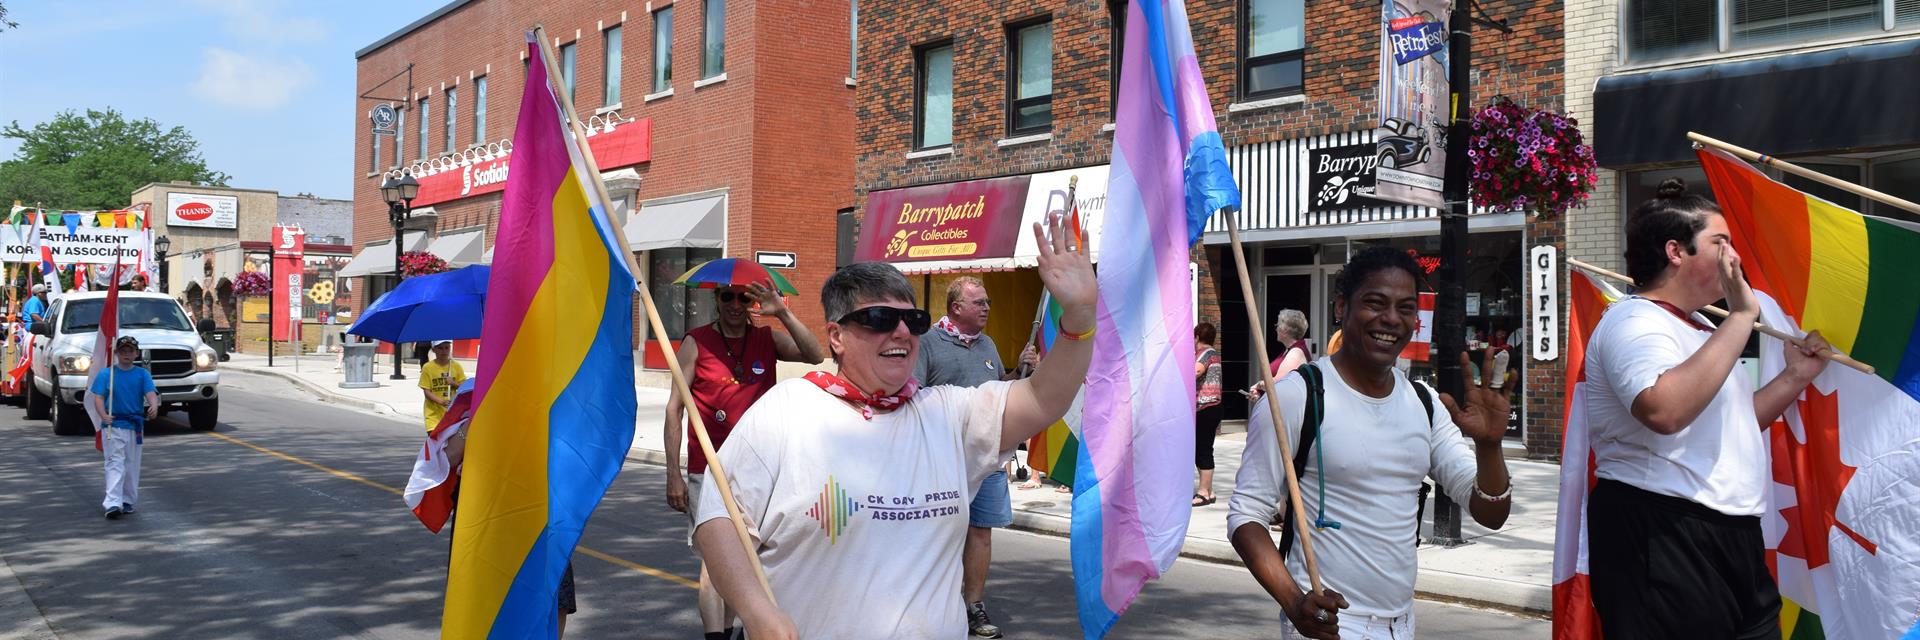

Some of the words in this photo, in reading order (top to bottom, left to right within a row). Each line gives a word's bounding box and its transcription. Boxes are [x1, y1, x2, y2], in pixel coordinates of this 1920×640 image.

[1390, 25, 1444, 59] RetroFest
[1316, 154, 1378, 175] Barryp
[474, 161, 509, 188] Scotiab
[176, 207, 213, 216] THANKS!
[897, 195, 985, 227] Barrypatch
[47, 233, 129, 244] ATHAM-KENT
[921, 228, 968, 241] Collectibles
[6, 245, 60, 255] KORN
[65, 247, 139, 257] ASSOCIATIO
[1538, 253, 1550, 353] GIFTS
[868, 495, 884, 504] CK
[893, 496, 915, 506] GAY
[925, 490, 960, 503] PRIDE
[872, 505, 960, 521] ASSOCIATION
